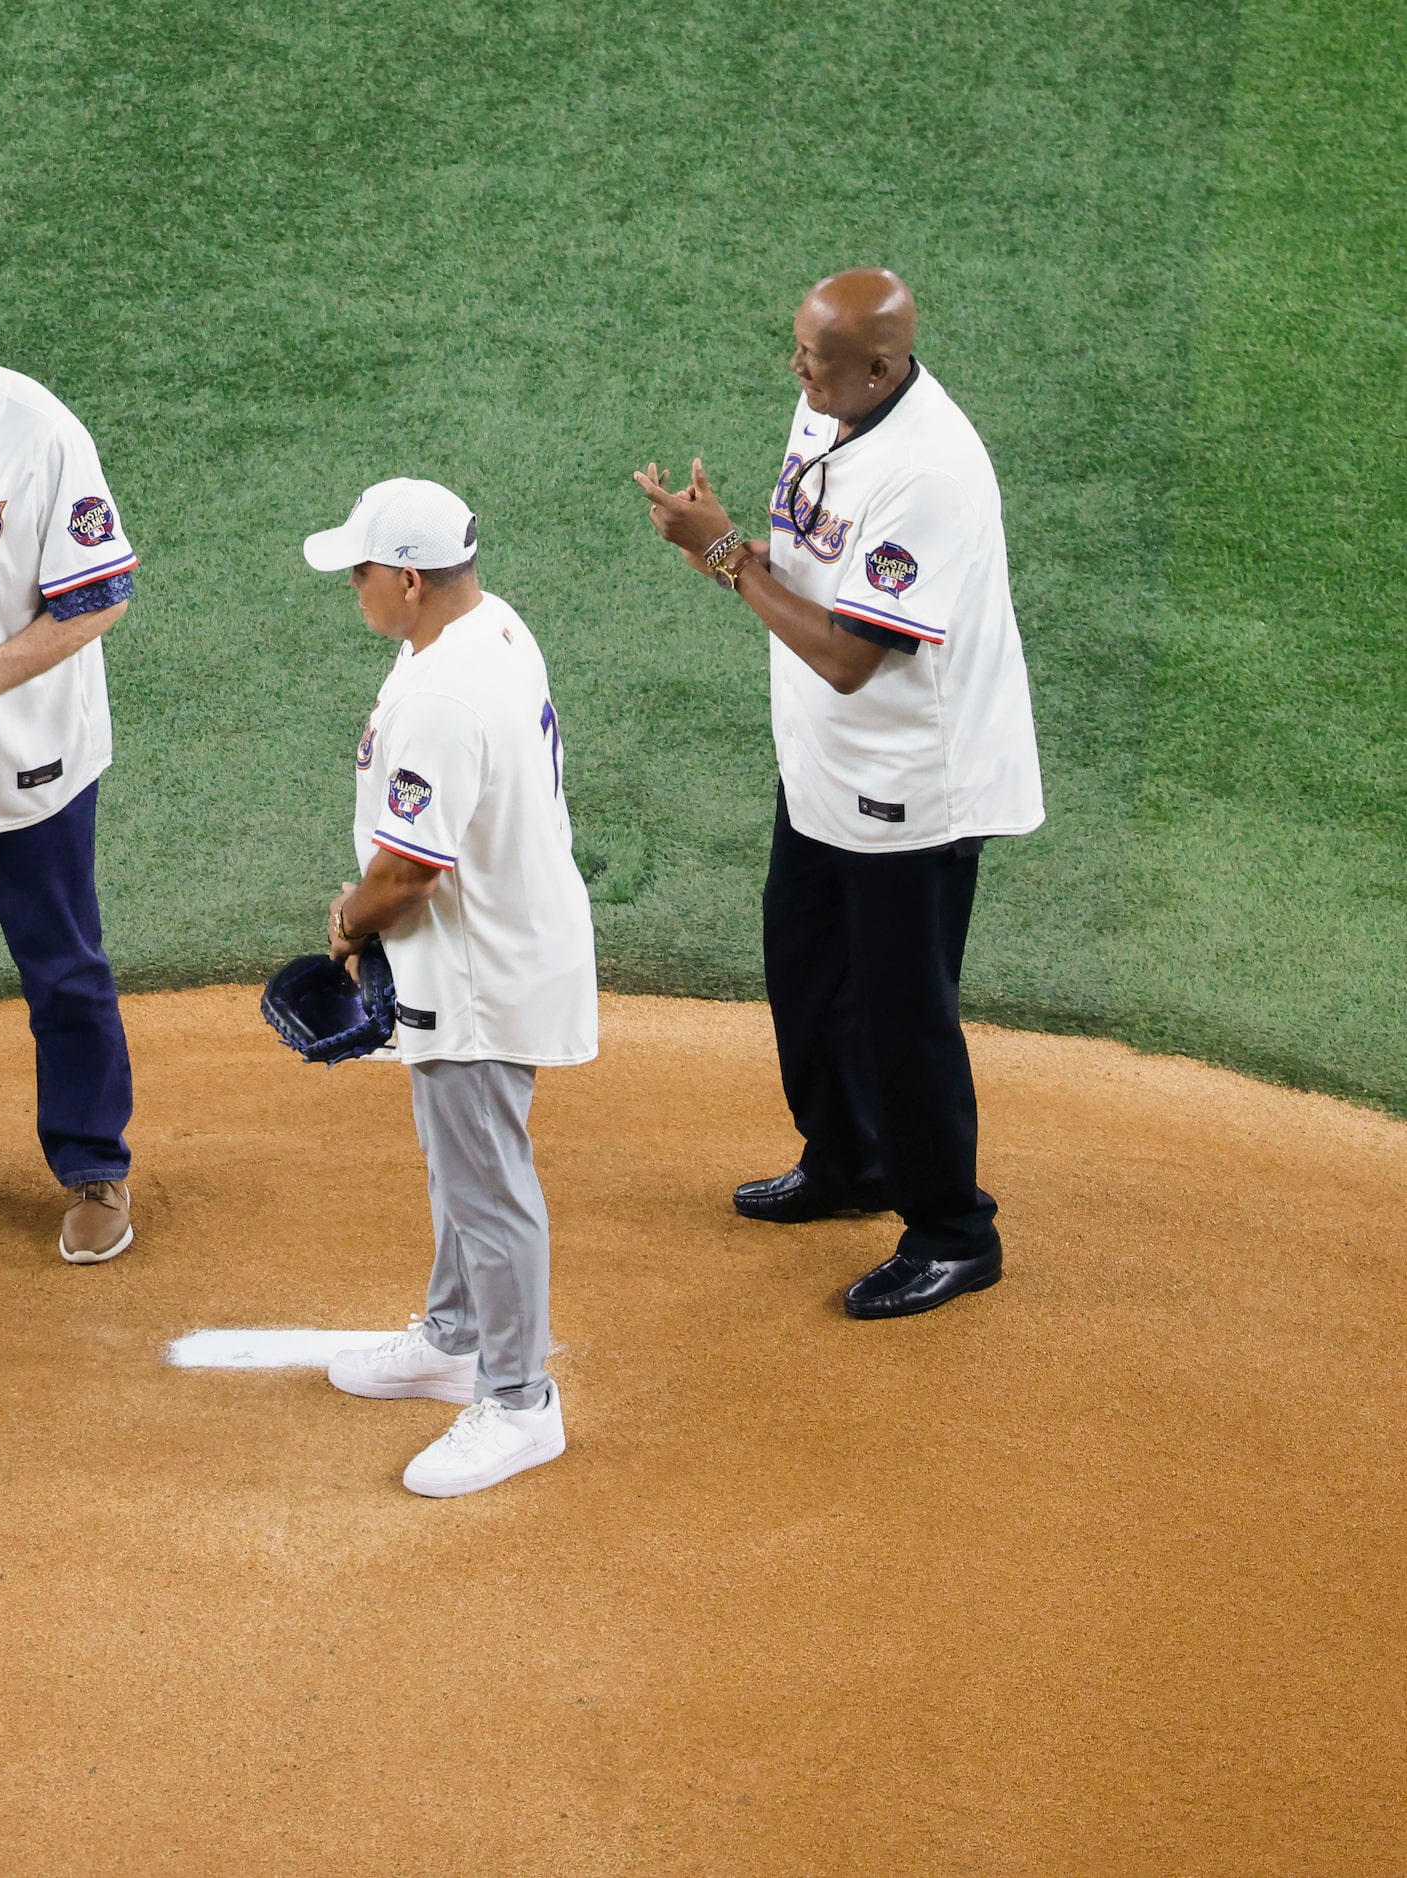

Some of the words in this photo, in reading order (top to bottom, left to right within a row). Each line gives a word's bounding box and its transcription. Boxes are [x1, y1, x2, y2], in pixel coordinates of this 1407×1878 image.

[770, 452, 854, 564] Rners
[79, 514, 107, 534] GAME
[876, 565, 906, 582] GAME
[397, 790, 423, 806] GAME
